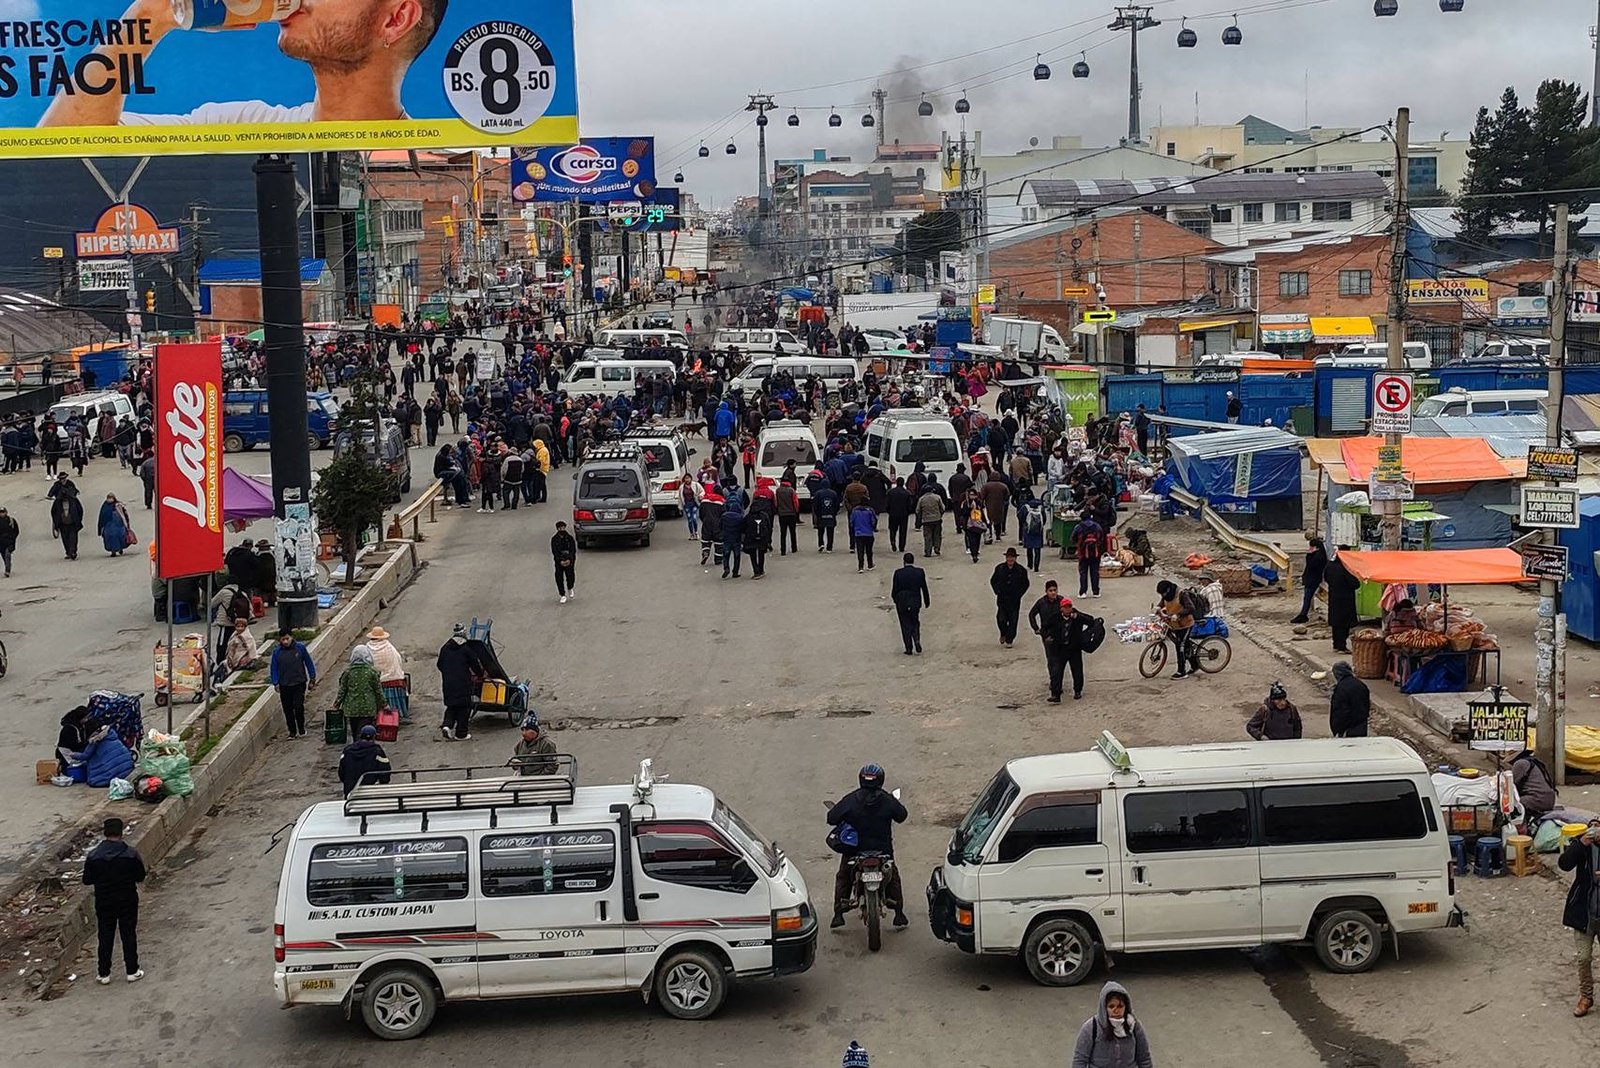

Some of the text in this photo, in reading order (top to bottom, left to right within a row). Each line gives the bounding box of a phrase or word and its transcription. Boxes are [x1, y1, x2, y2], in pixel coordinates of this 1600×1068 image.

[453, 22, 543, 53] PRECIO SUGERIDO
[29, 48, 155, 97] FÁCIL
[451, 36, 549, 115] BS. 8 .50
[481, 118, 524, 127] LATA 440 mL
[29, 137, 68, 146] EXCESIVO
[70, 137, 81, 145] DE
[82, 136, 121, 144] ALCOHOL
[135, 134, 168, 143] DAÑINO
[169, 135, 191, 143] PARA
[192, 134, 201, 142] LA
[236, 133, 262, 141] VENTA
[263, 132, 307, 141] PROHIBIDA
[308, 132, 315, 140] A
[316, 131, 354, 140] MENORES
[356, 131, 367, 139] DE
[369, 131, 379, 139] 18
[380, 129, 403, 138] AÑOS
[405, 130, 415, 138] DE
[417, 129, 441, 137] EDAD.
[569, 157, 615, 169] carsa
[552, 184, 580, 194] mundo
[582, 184, 591, 193] de
[592, 180, 631, 195] galletitas!
[609, 206, 641, 214] PEPSI
[647, 209, 664, 223] 29
[80, 233, 176, 253] HIPERMAXI
[1423, 280, 1466, 288] Pollos
[1403, 288, 1486, 298] SENSACIONAL
[1376, 412, 1408, 420] PROHIBIDO
[162, 381, 206, 528] Late
[1529, 452, 1576, 465] TRUENO
[1527, 492, 1573, 502] MARIACHI
[1528, 502, 1544, 511] LOS
[1471, 718, 1498, 730] CALDO
[1504, 718, 1525, 730] PATA
[1498, 729, 1525, 740] FIDEO
[489, 836, 539, 848] CONFORT
[558, 835, 603, 845] CALIDAD
[401, 841, 446, 853] TURISMO
[321, 904, 436, 920] S.A.D. CUSTOM JAPAN
[539, 929, 585, 939] TOYOTA
